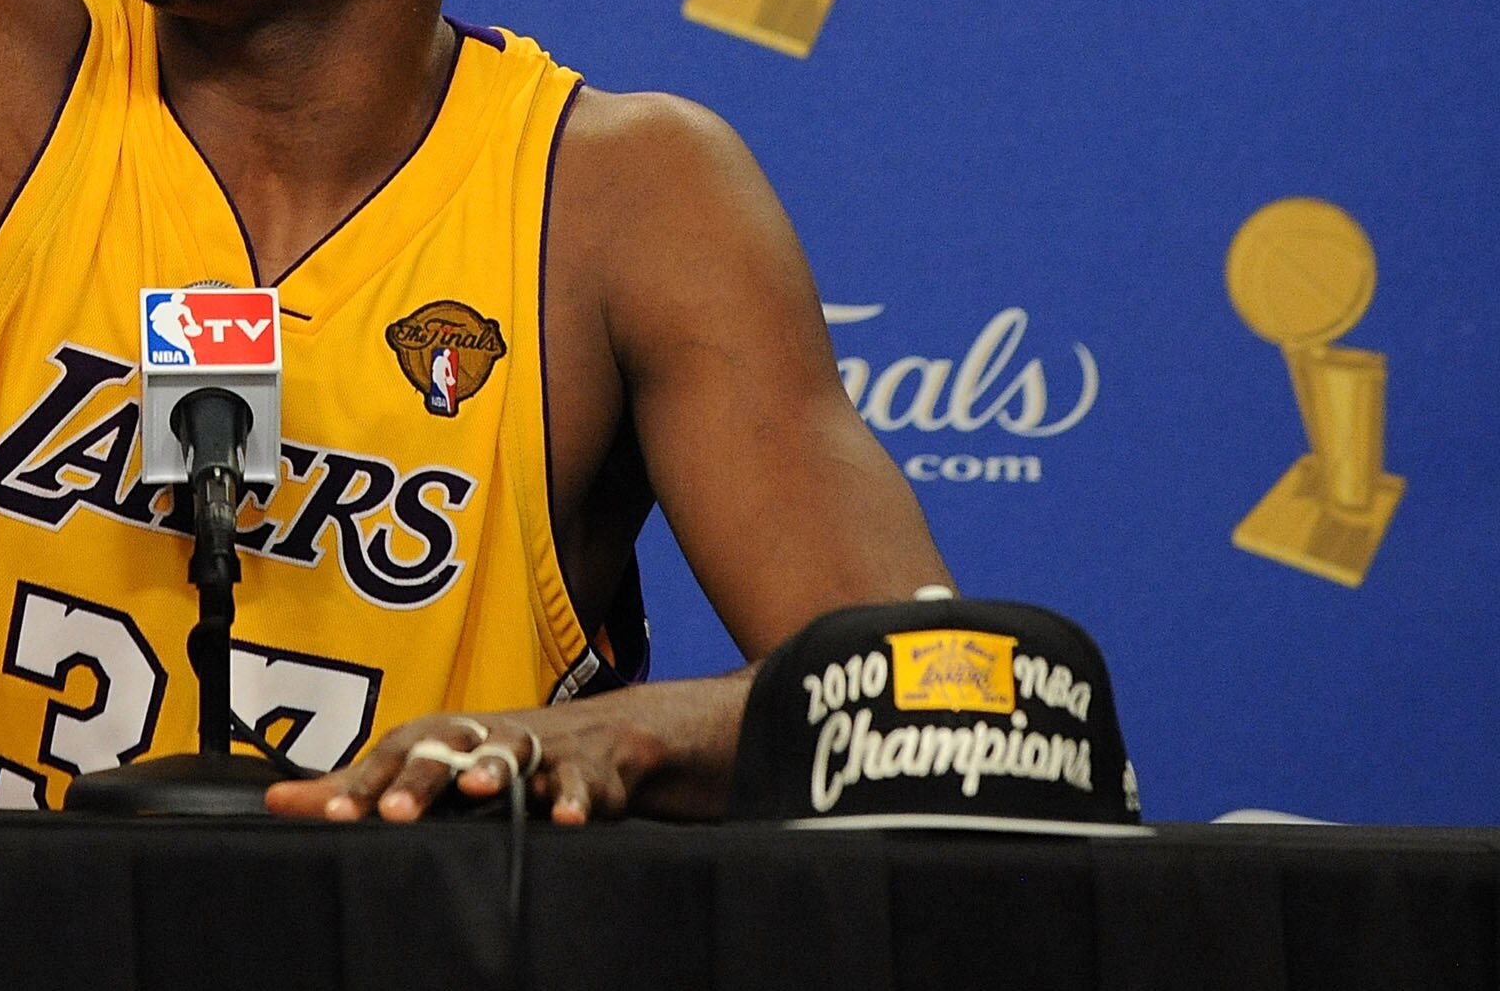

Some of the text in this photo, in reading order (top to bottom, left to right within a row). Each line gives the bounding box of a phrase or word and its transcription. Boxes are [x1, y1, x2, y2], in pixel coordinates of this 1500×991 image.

[152, 318, 273, 364] NBA TV
[395, 318, 499, 351] The Finals
[803, 650, 888, 726] 2010
[810, 708, 1093, 812] Champions
